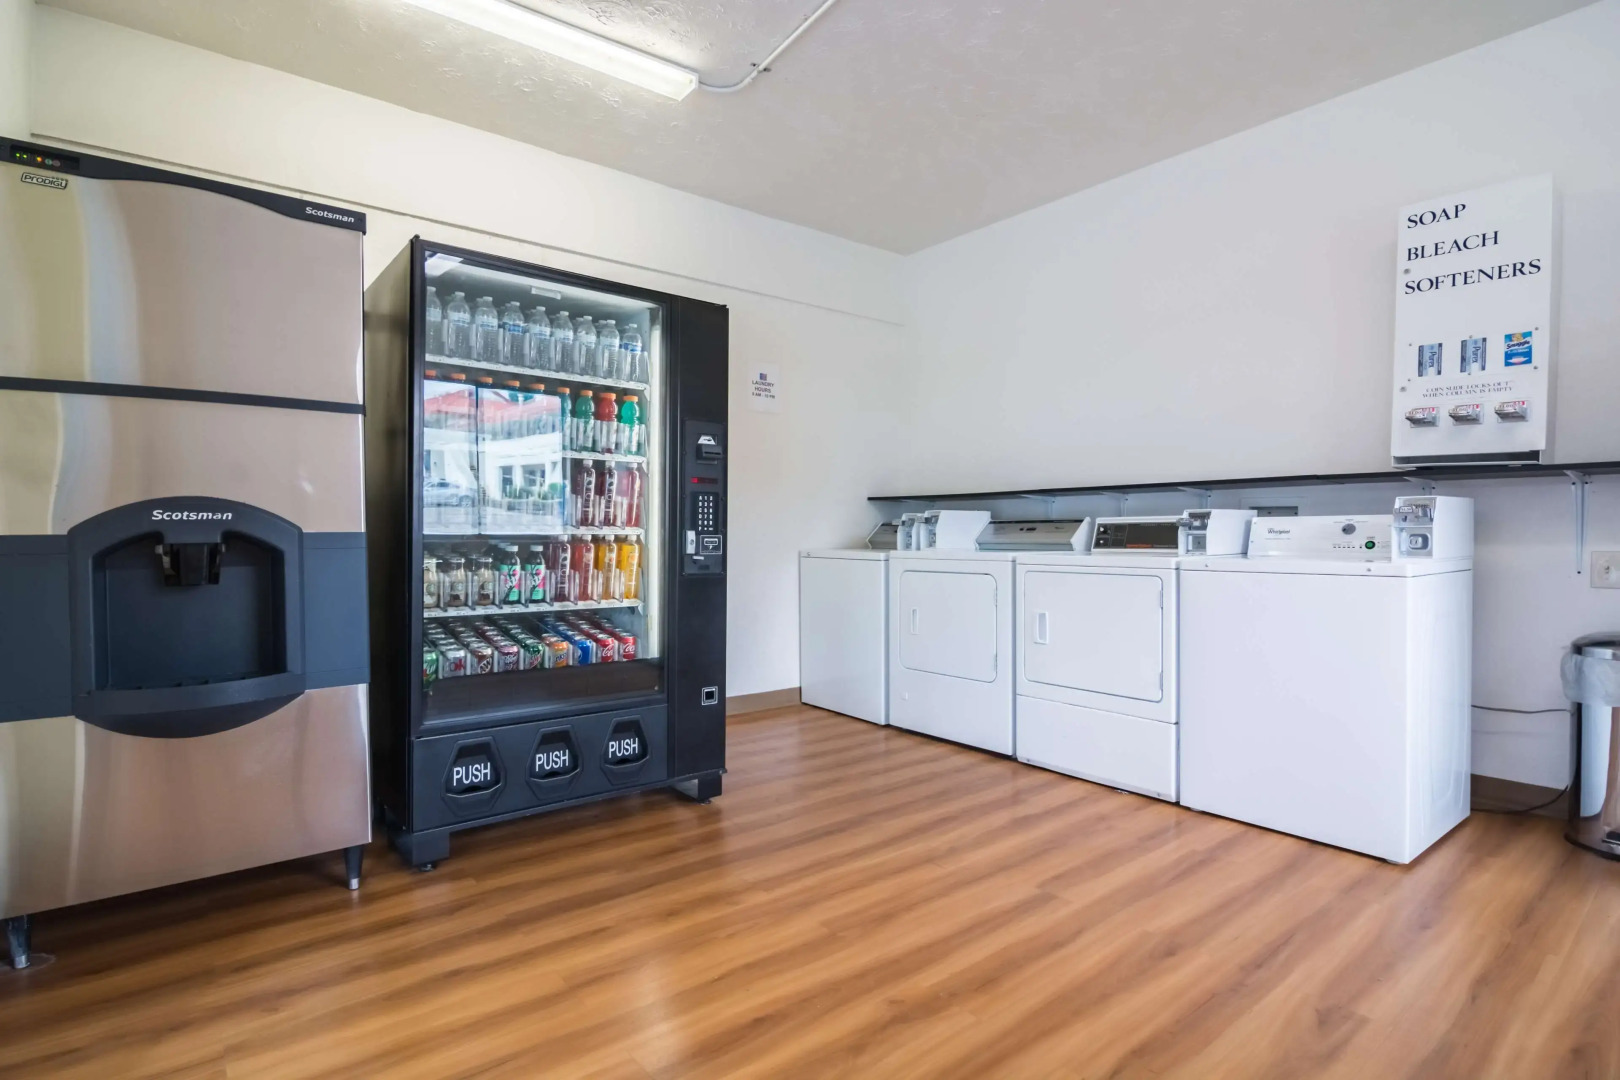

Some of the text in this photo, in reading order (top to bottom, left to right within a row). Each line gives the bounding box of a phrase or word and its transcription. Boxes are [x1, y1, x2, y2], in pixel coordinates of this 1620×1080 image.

[305, 206, 355, 223] Scotsman
[1407, 203, 1466, 229] SOAP
[1406, 230, 1500, 262] BLEACH
[1404, 258, 1542, 295] SOFTENERS
[151, 509, 233, 520] Scotsman
[608, 737, 639, 759] PUSH
[535, 749, 569, 772] PUSH
[453, 762, 491, 787] PUSH
